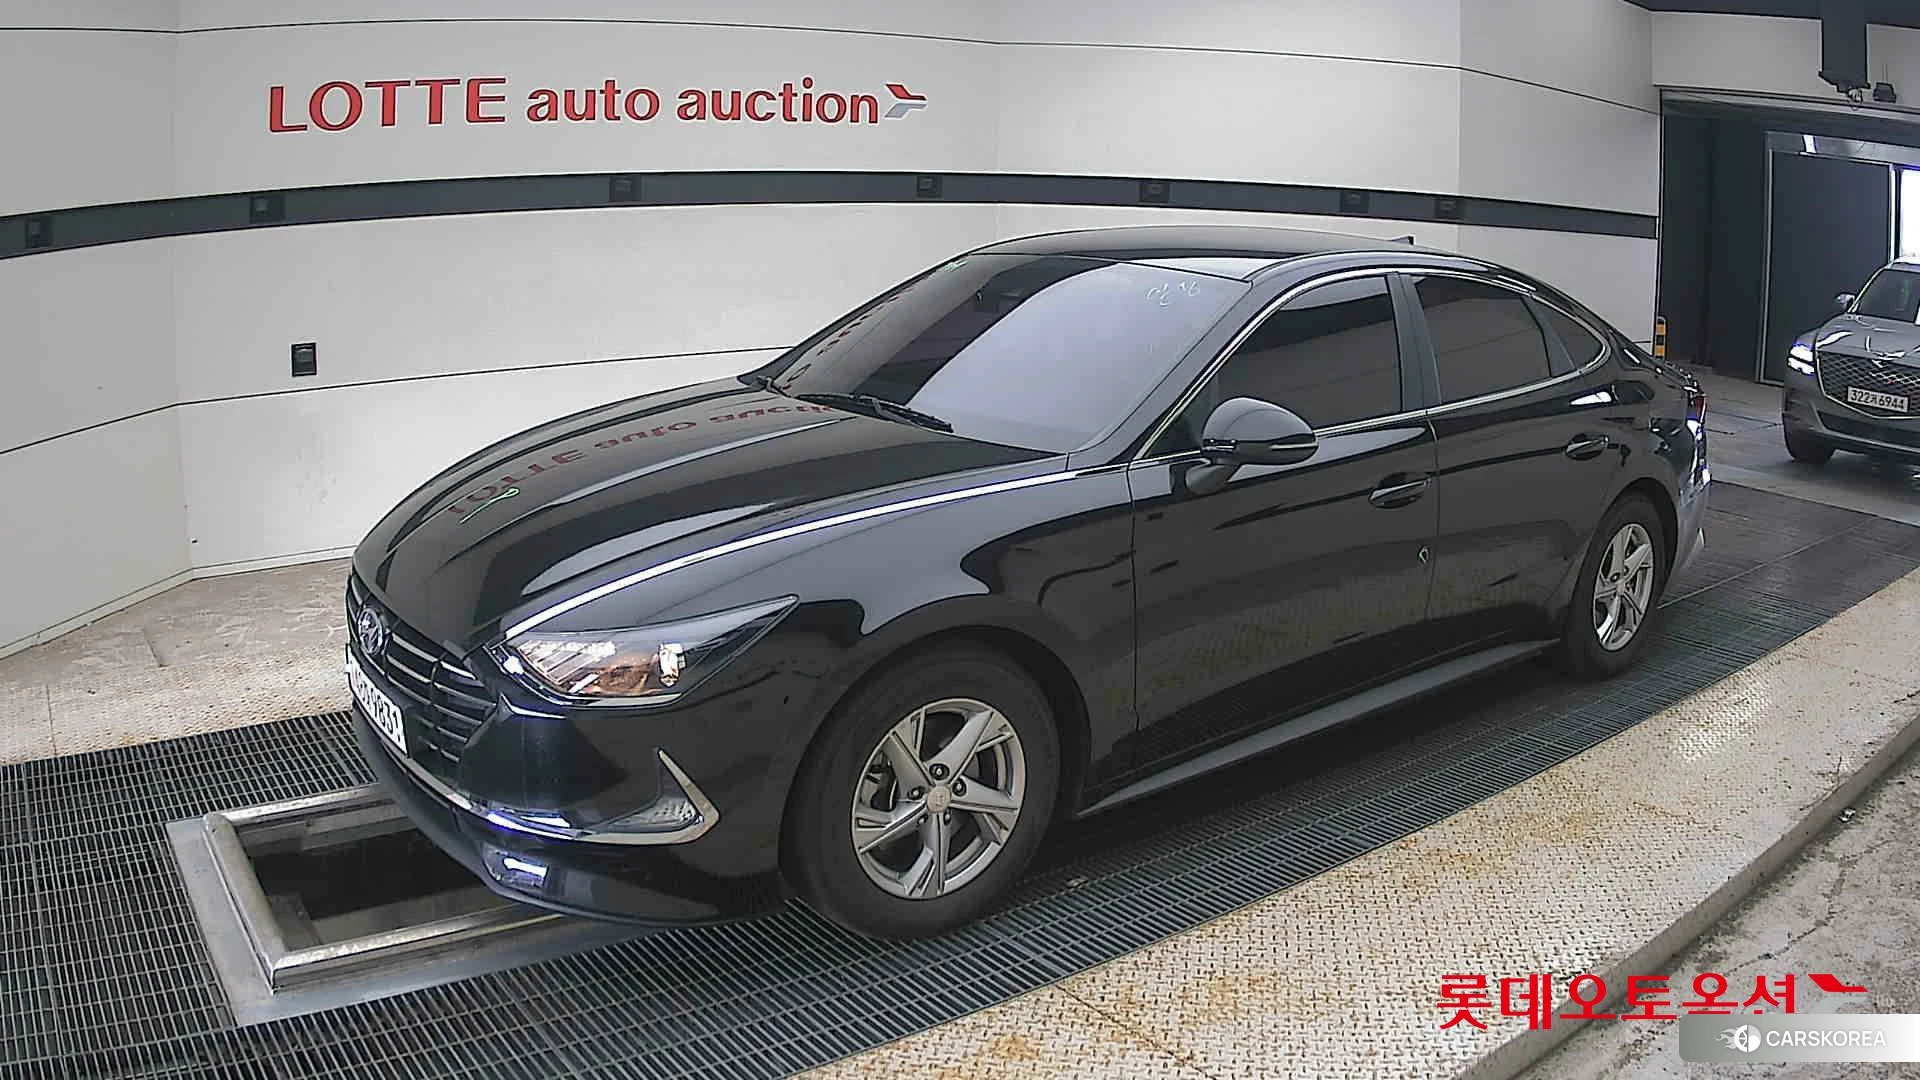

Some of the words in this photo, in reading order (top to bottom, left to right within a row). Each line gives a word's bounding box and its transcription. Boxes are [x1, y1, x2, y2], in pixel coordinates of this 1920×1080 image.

[269, 77, 507, 133] LOTTE
[526, 79, 660, 122] auto
[676, 77, 879, 124] auction
